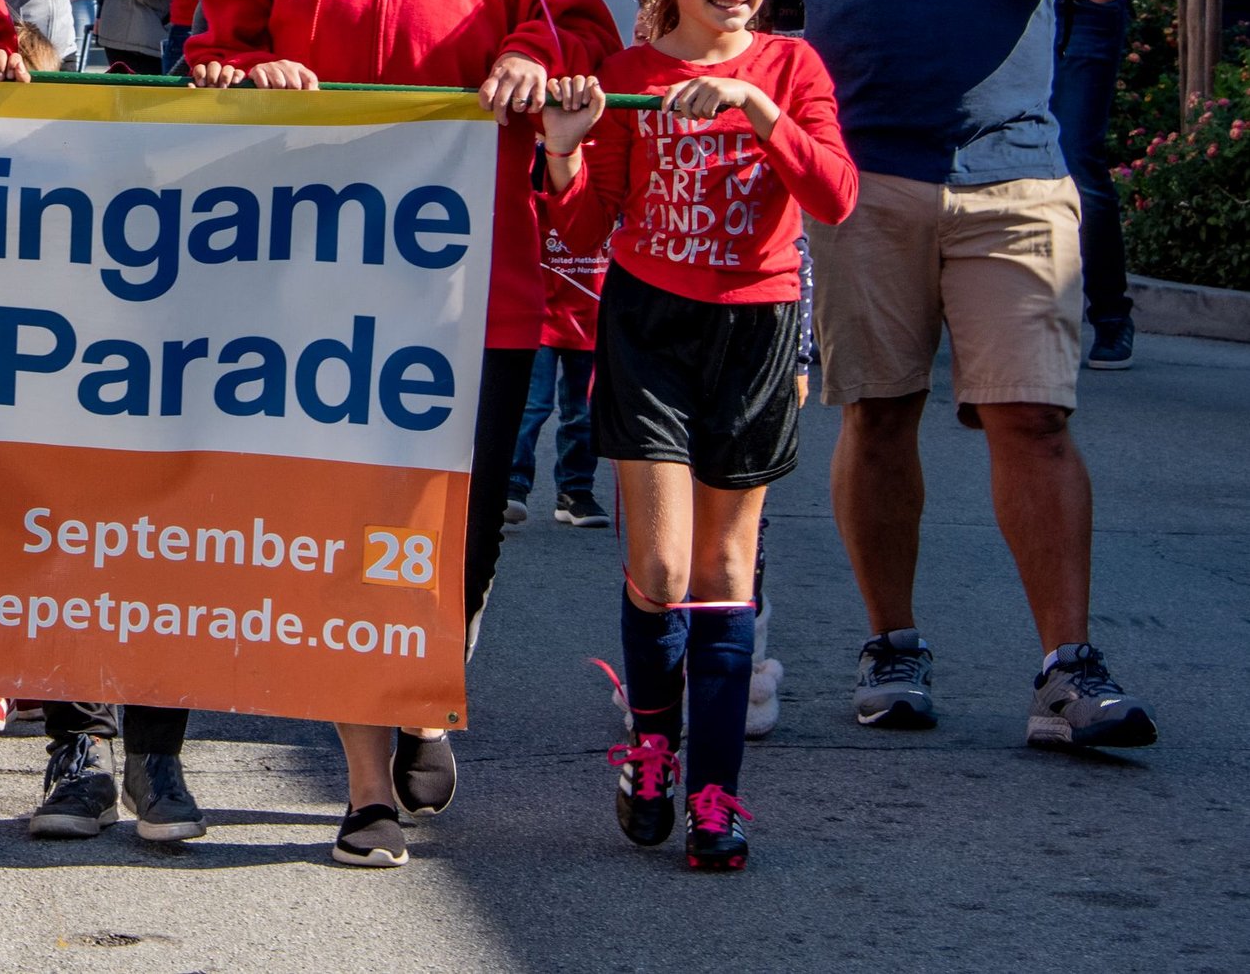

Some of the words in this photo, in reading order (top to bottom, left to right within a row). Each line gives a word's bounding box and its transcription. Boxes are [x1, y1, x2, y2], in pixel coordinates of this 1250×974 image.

[648, 134, 752, 170] EOPLE
[645, 169, 708, 203] ARE
[726, 163, 769, 200] M
[725, 200, 761, 235] OF
[23, 507, 345, 574] September
[365, 532, 436, 584] 28
